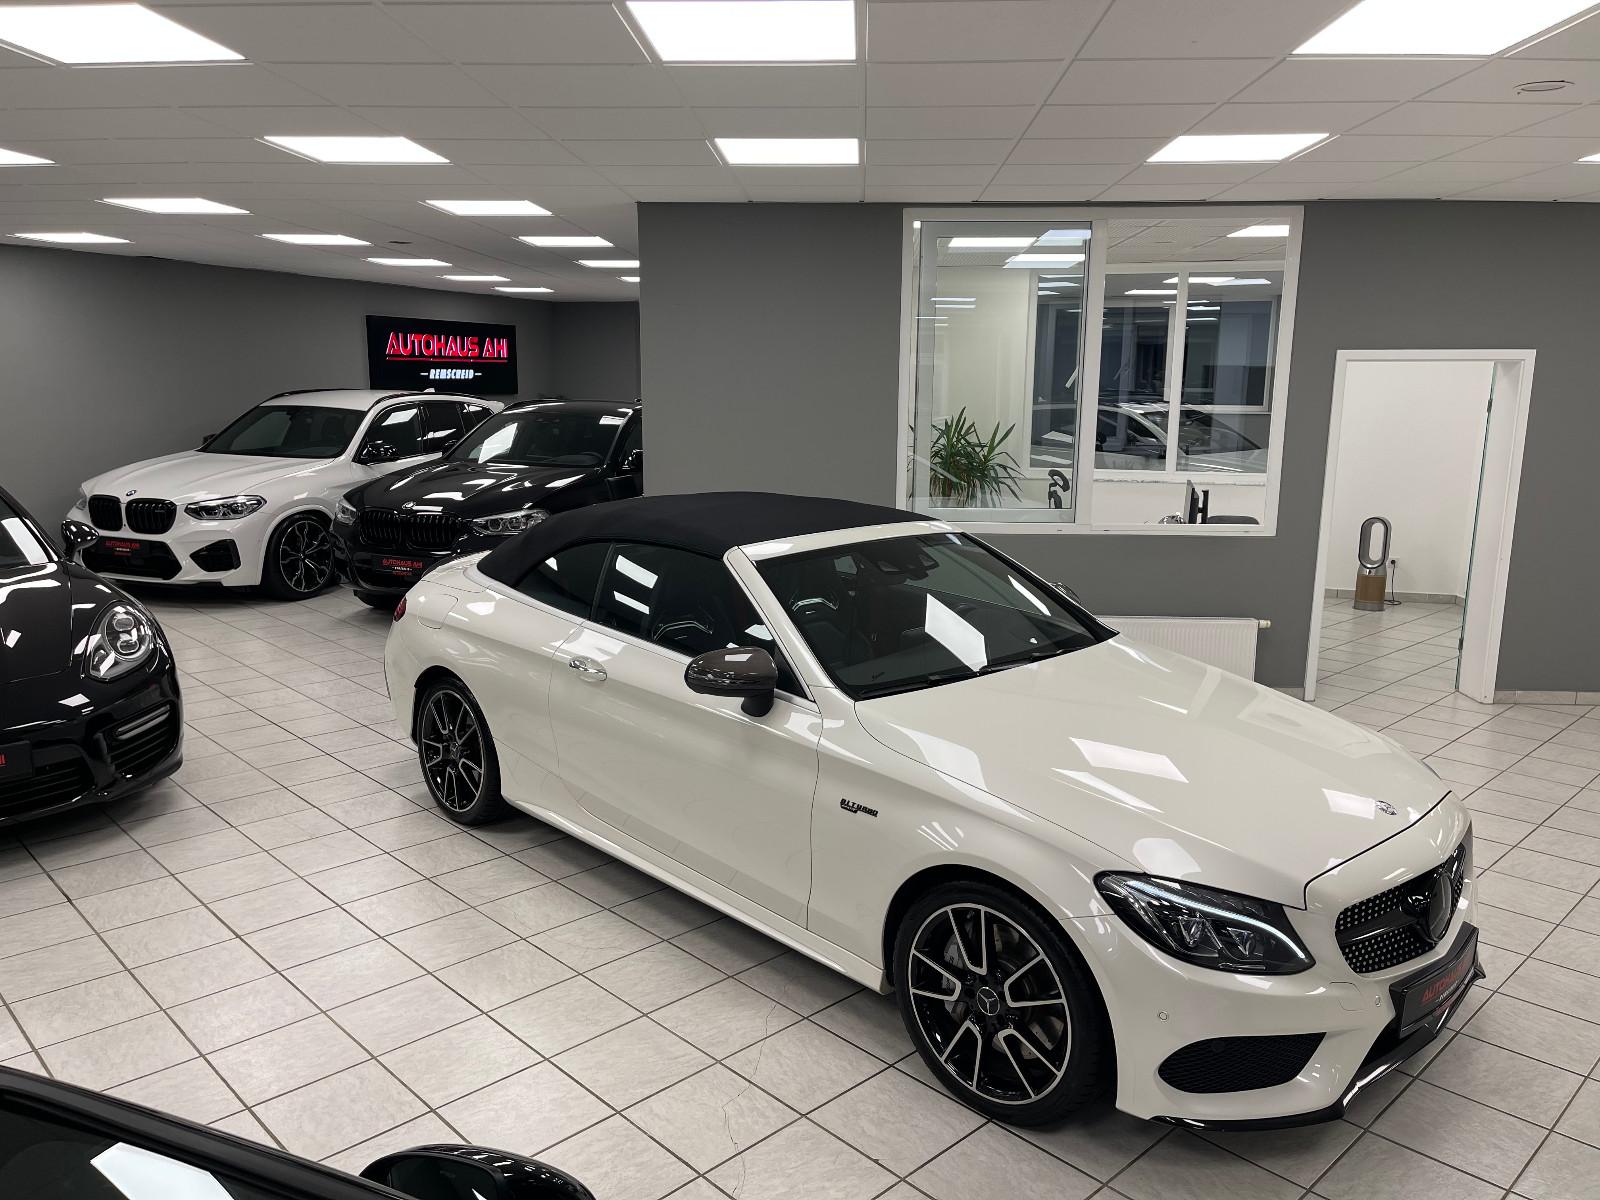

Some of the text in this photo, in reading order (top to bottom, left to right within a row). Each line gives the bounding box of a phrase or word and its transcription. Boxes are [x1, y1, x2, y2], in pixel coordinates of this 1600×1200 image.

[386, 331, 508, 358] AUTOHAUS AHI
[429, 369, 474, 380] REMSCHEID
